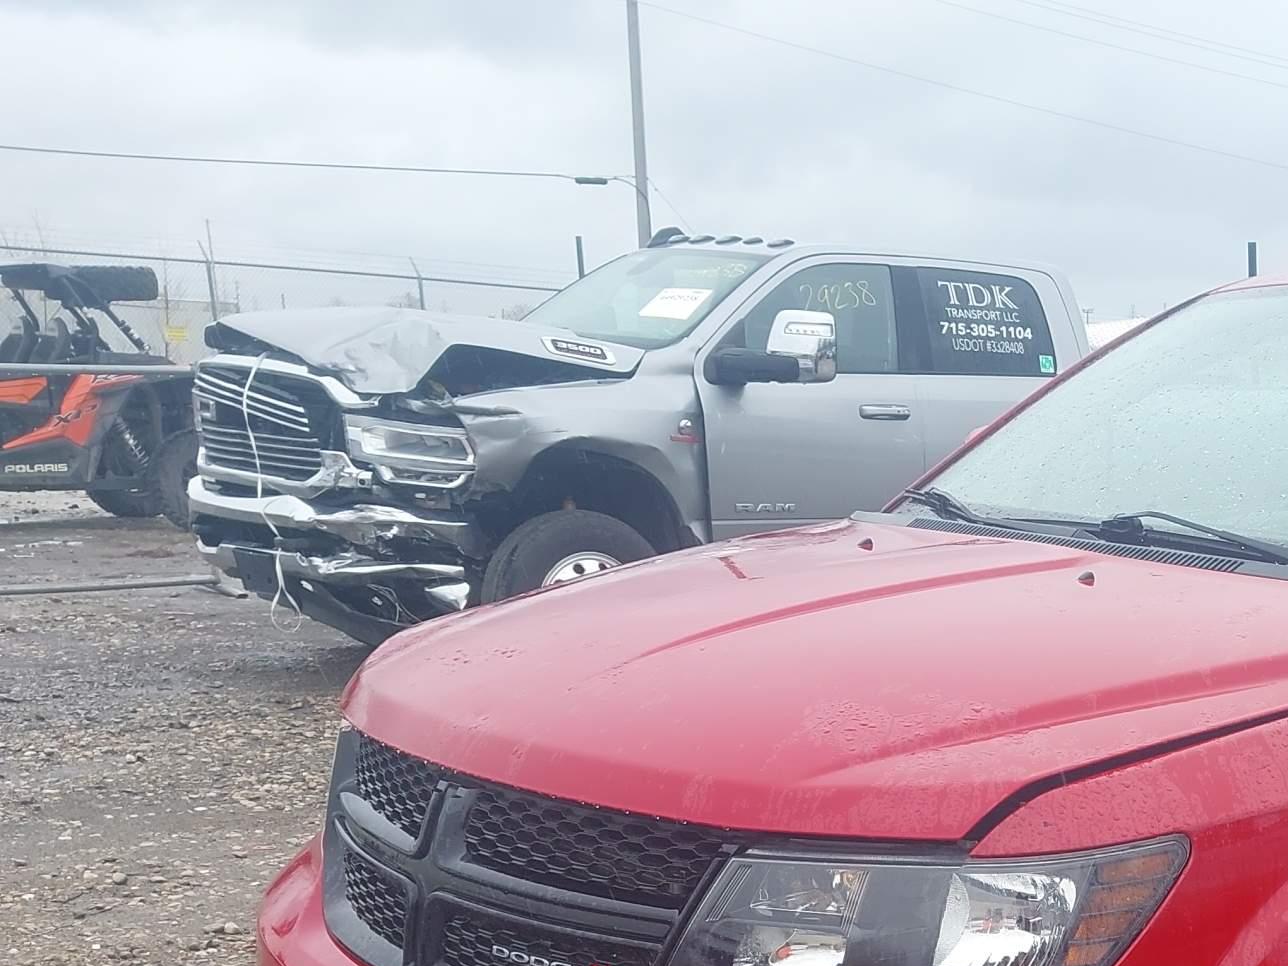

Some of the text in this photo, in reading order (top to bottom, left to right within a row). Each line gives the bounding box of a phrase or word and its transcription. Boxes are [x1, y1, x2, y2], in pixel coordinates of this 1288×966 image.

[937, 280, 1019, 310] TDK
[945, 307, 1020, 323] TRANSPORT LLC
[939, 321, 1033, 340] 715-305-1104
[952, 337, 984, 353] USDOT
[4, 463, 69, 473] POLARIS
[735, 503, 797, 513] RAM
